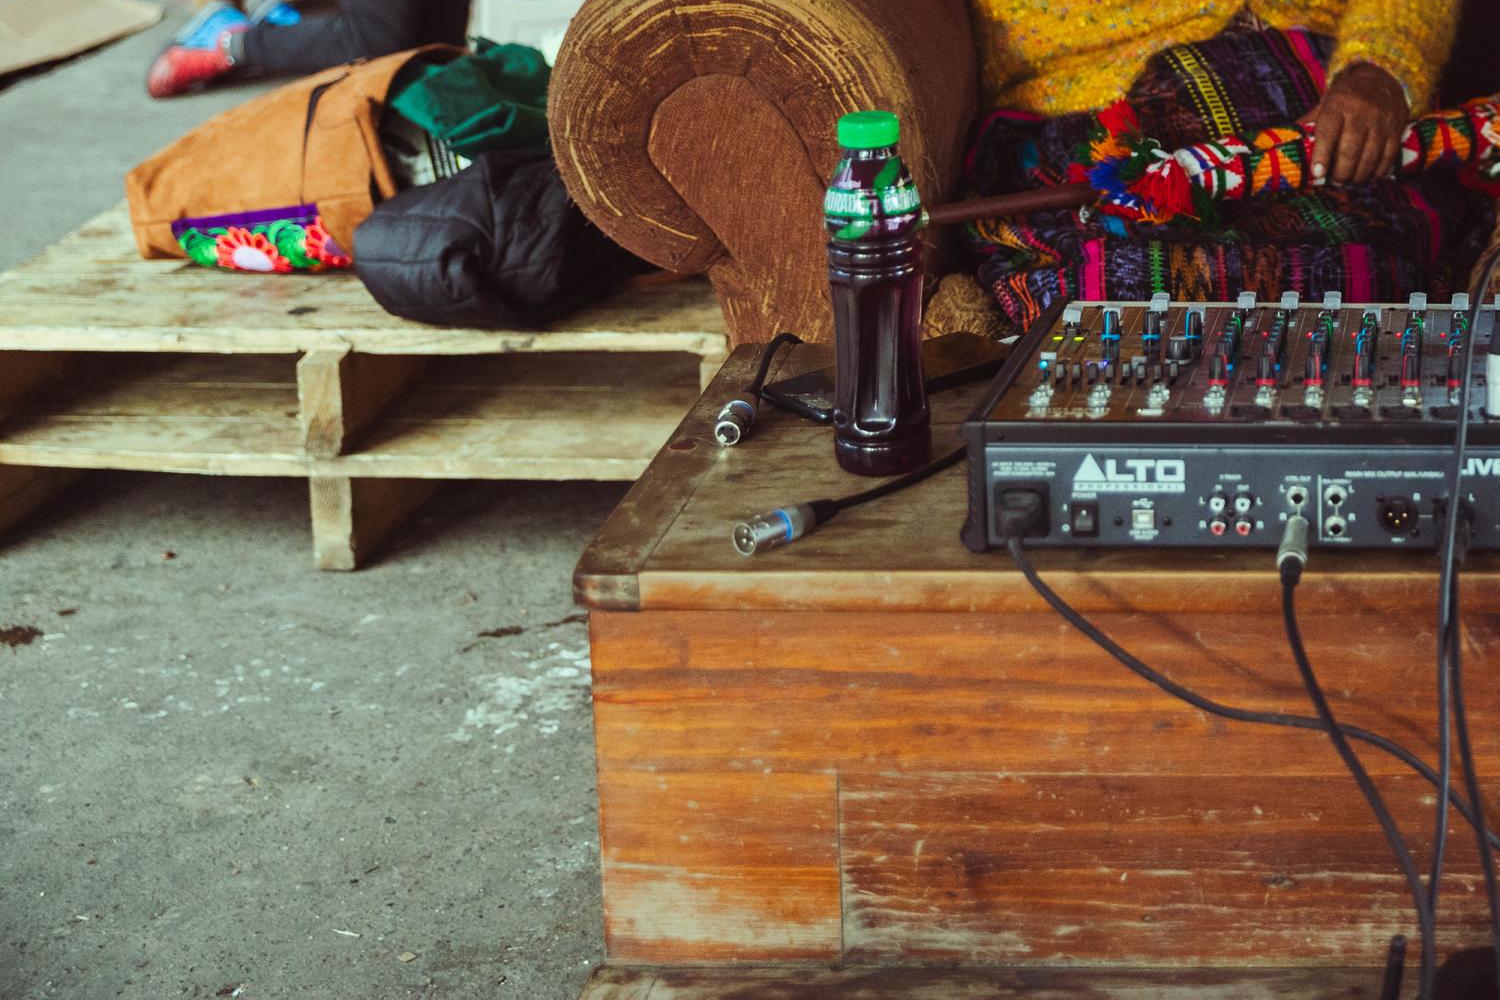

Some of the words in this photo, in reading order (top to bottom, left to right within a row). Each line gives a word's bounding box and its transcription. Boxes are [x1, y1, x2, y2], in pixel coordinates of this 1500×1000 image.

[1073, 453, 1185, 482] ALTO
[1377, 470, 1402, 478] OUTPUT
[1075, 482, 1183, 492] PROFESSIONAL
